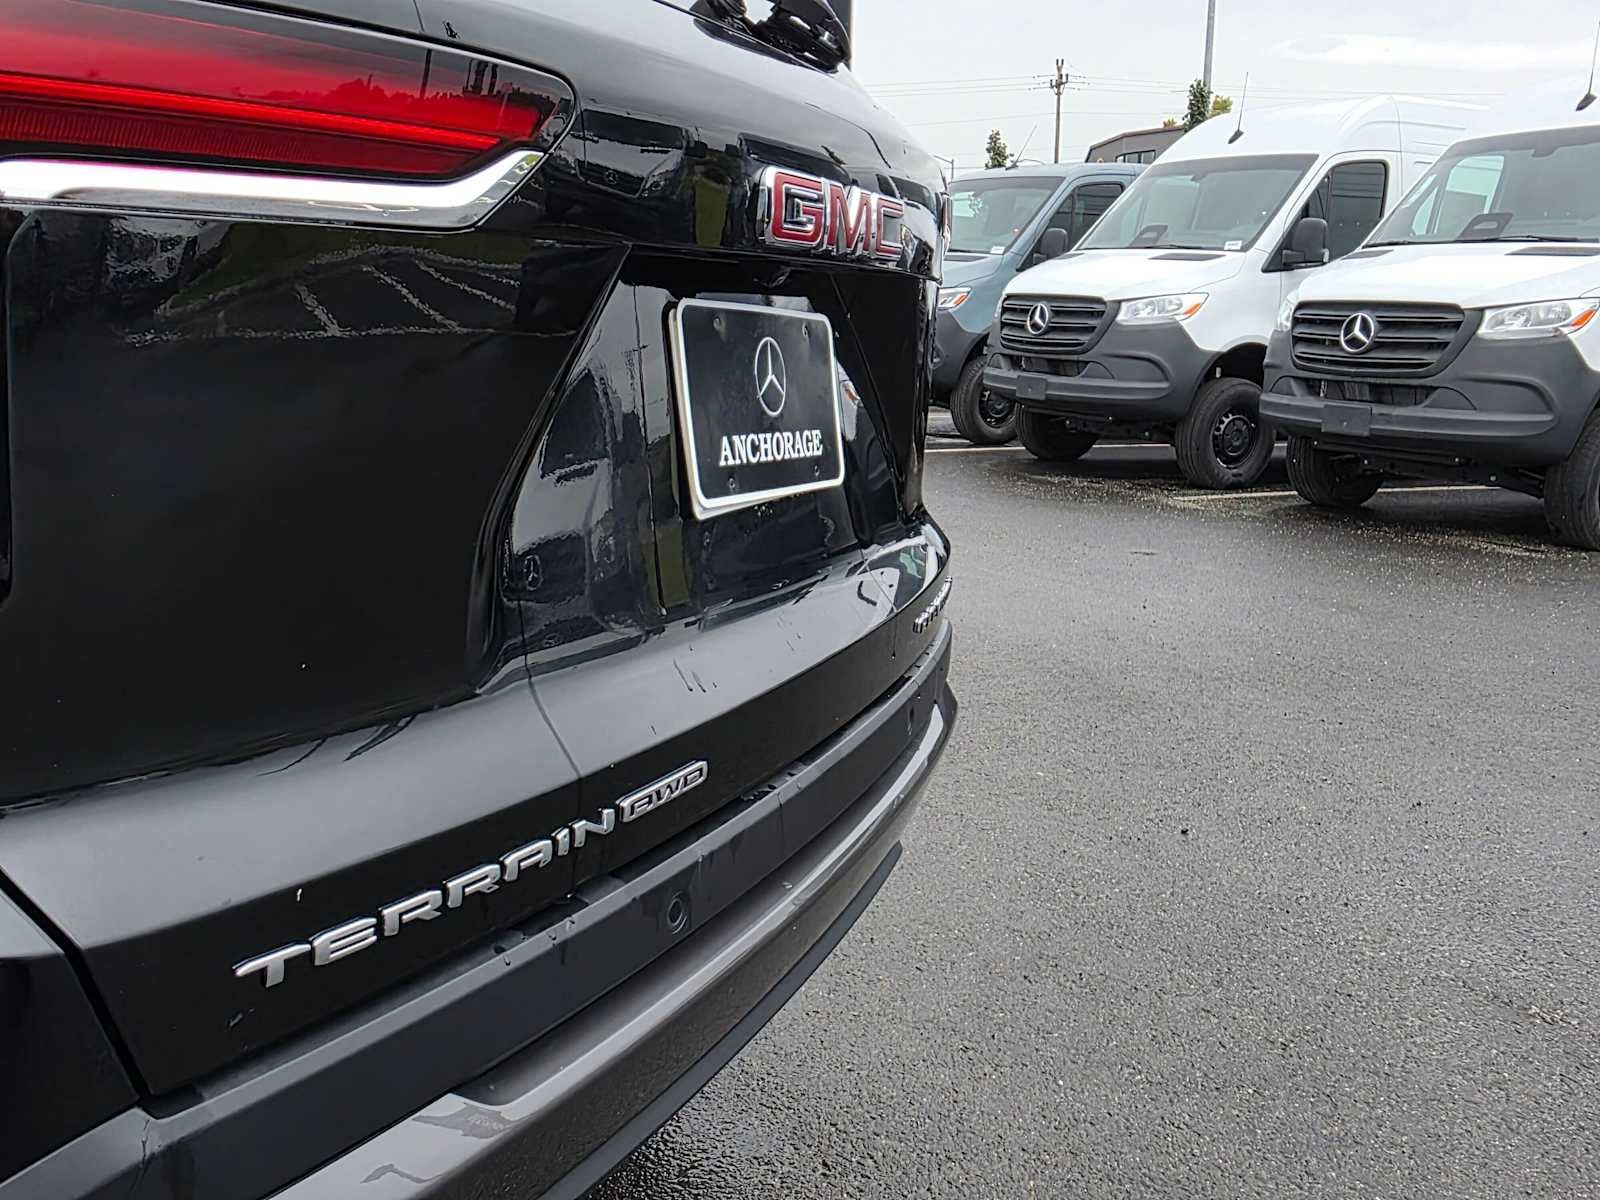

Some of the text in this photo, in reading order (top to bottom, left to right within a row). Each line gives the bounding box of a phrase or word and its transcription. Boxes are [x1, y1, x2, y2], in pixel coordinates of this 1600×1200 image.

[762, 165, 905, 260] GMC
[719, 430, 824, 467] ANCHORAGE
[233, 763, 707, 988] TERRAIN AWD
